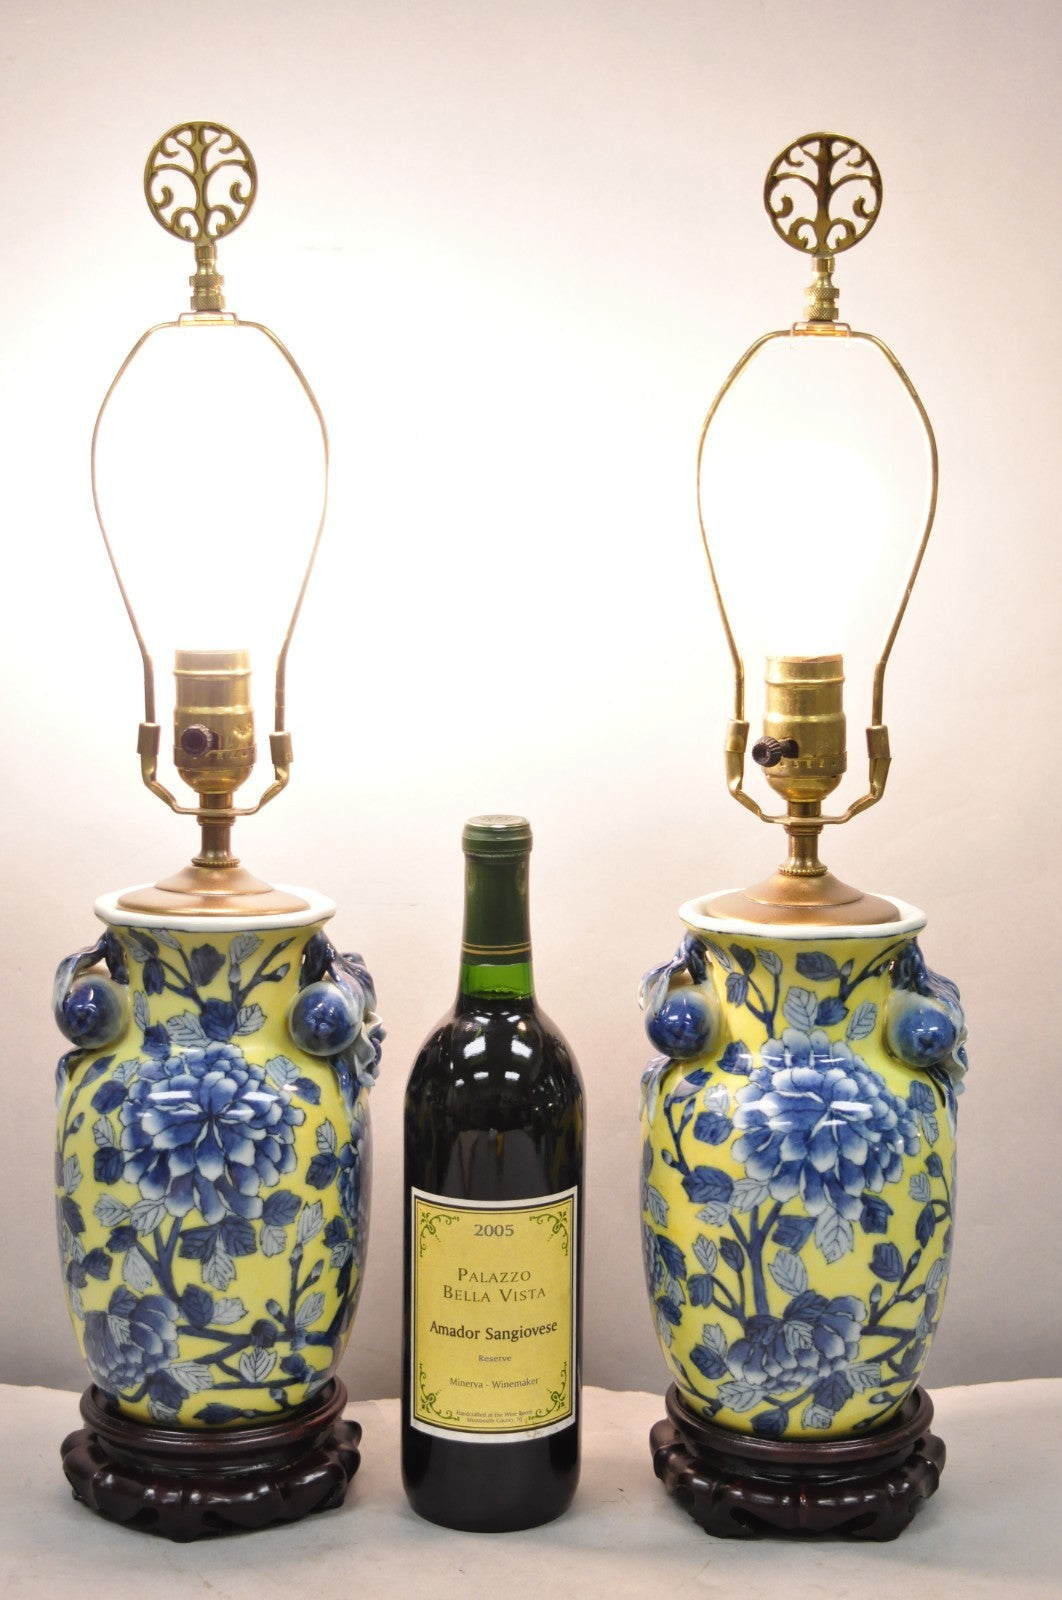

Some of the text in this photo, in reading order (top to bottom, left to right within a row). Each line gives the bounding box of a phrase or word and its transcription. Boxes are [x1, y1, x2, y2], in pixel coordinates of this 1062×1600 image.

[474, 1224, 514, 1237] 2005
[458, 1267, 531, 1283] PALAZZO
[443, 1285, 546, 1303] BELLA VISTA
[430, 1320, 558, 1343] Amador Sangiovese
[478, 1354, 512, 1362] Reserve
[449, 1377, 483, 1388] Minerva
[492, 1376, 539, 1389] Winemaker
